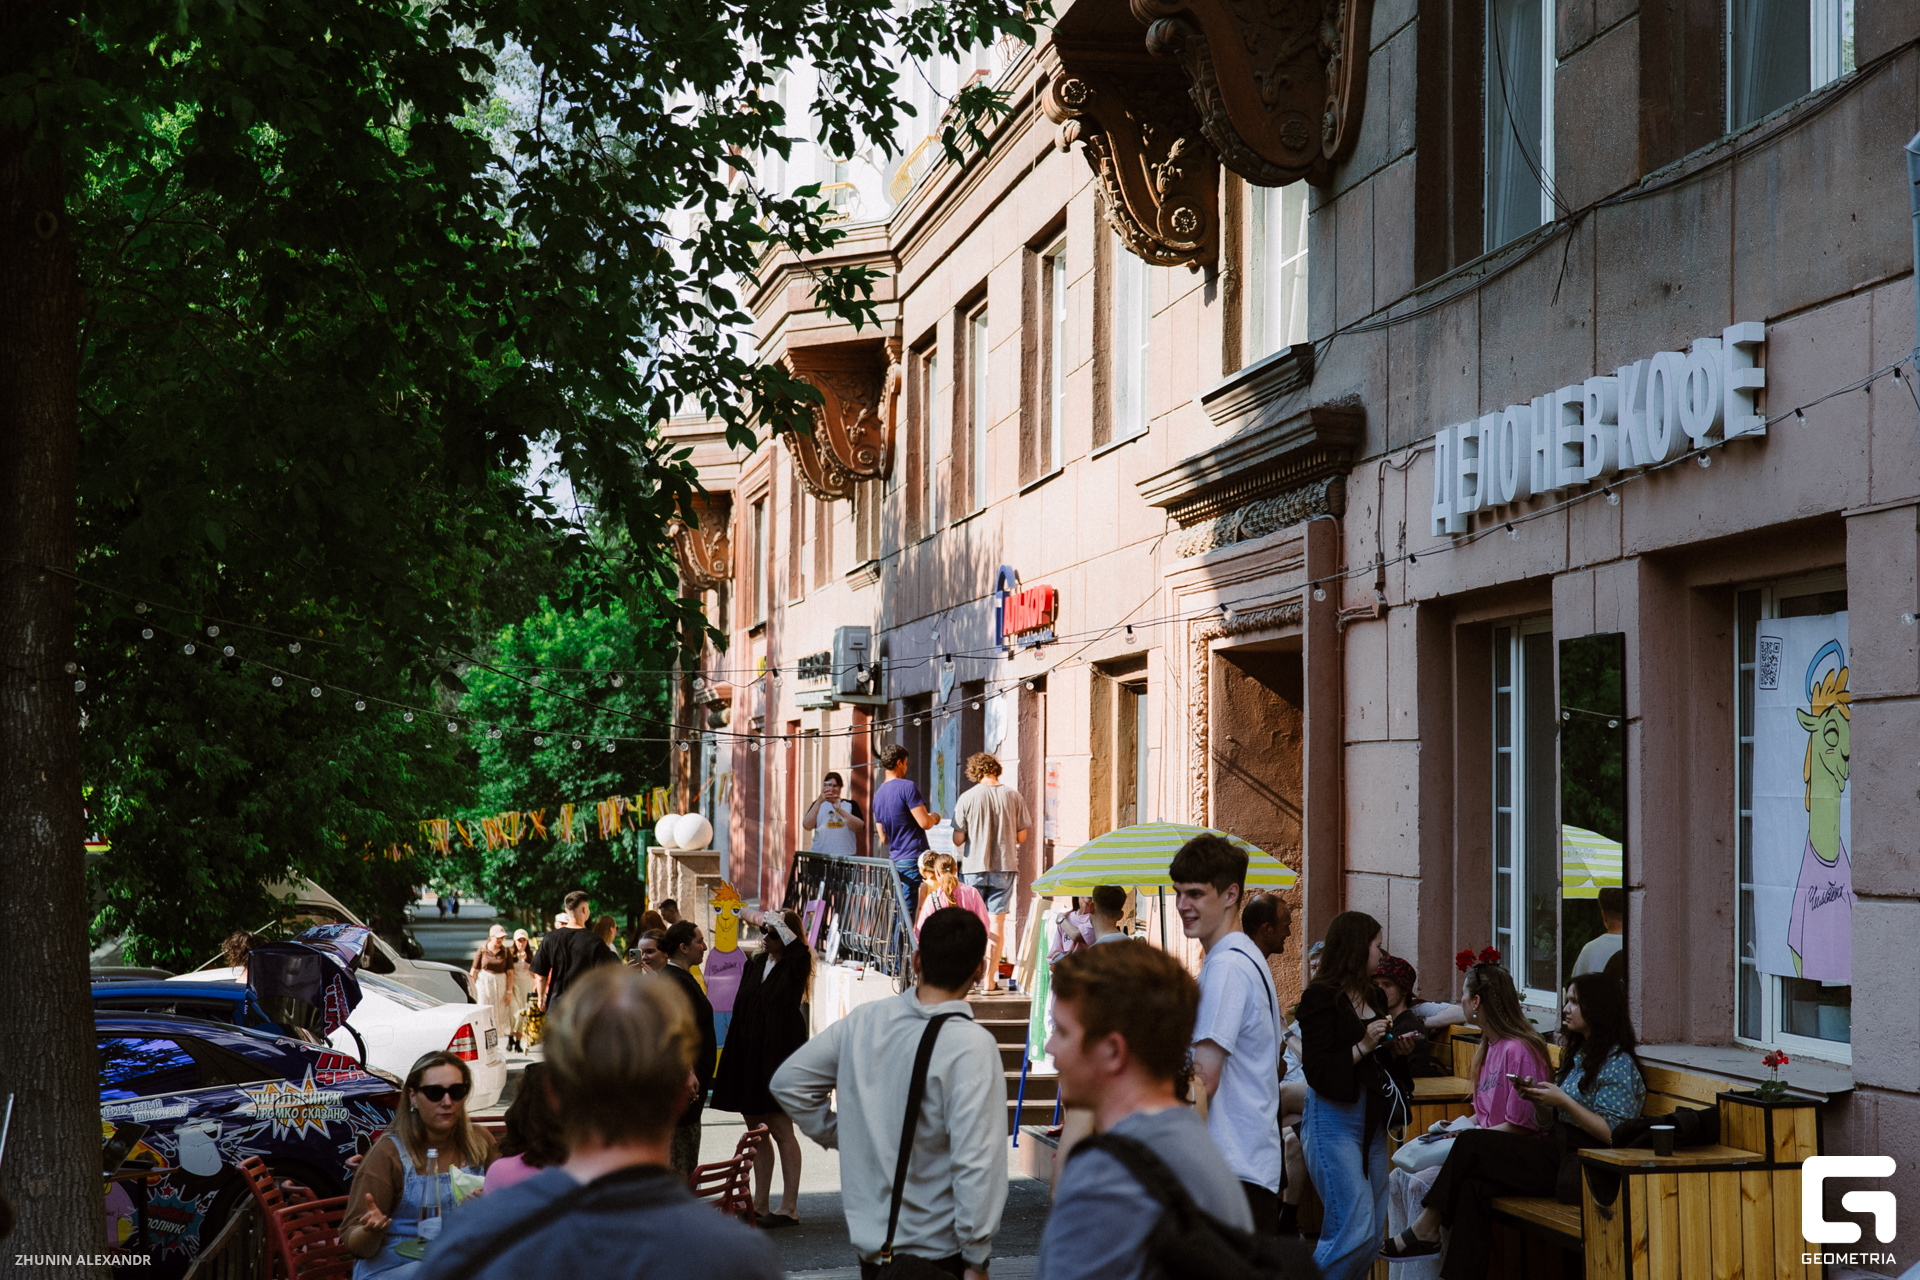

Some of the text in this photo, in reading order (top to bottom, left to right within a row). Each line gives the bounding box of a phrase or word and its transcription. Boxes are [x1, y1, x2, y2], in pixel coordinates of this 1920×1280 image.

[1431, 404, 1532, 537] ДЕЛО
[1617, 321, 1766, 471] КОФЕ
[315, 1052, 361, 1071] ПР
[251, 1091, 344, 1107] ЧИЛЛЯБИНСК
[256, 1108, 299, 1119] ГРОМКО
[301, 1107, 349, 1120] СКАЗАНО
